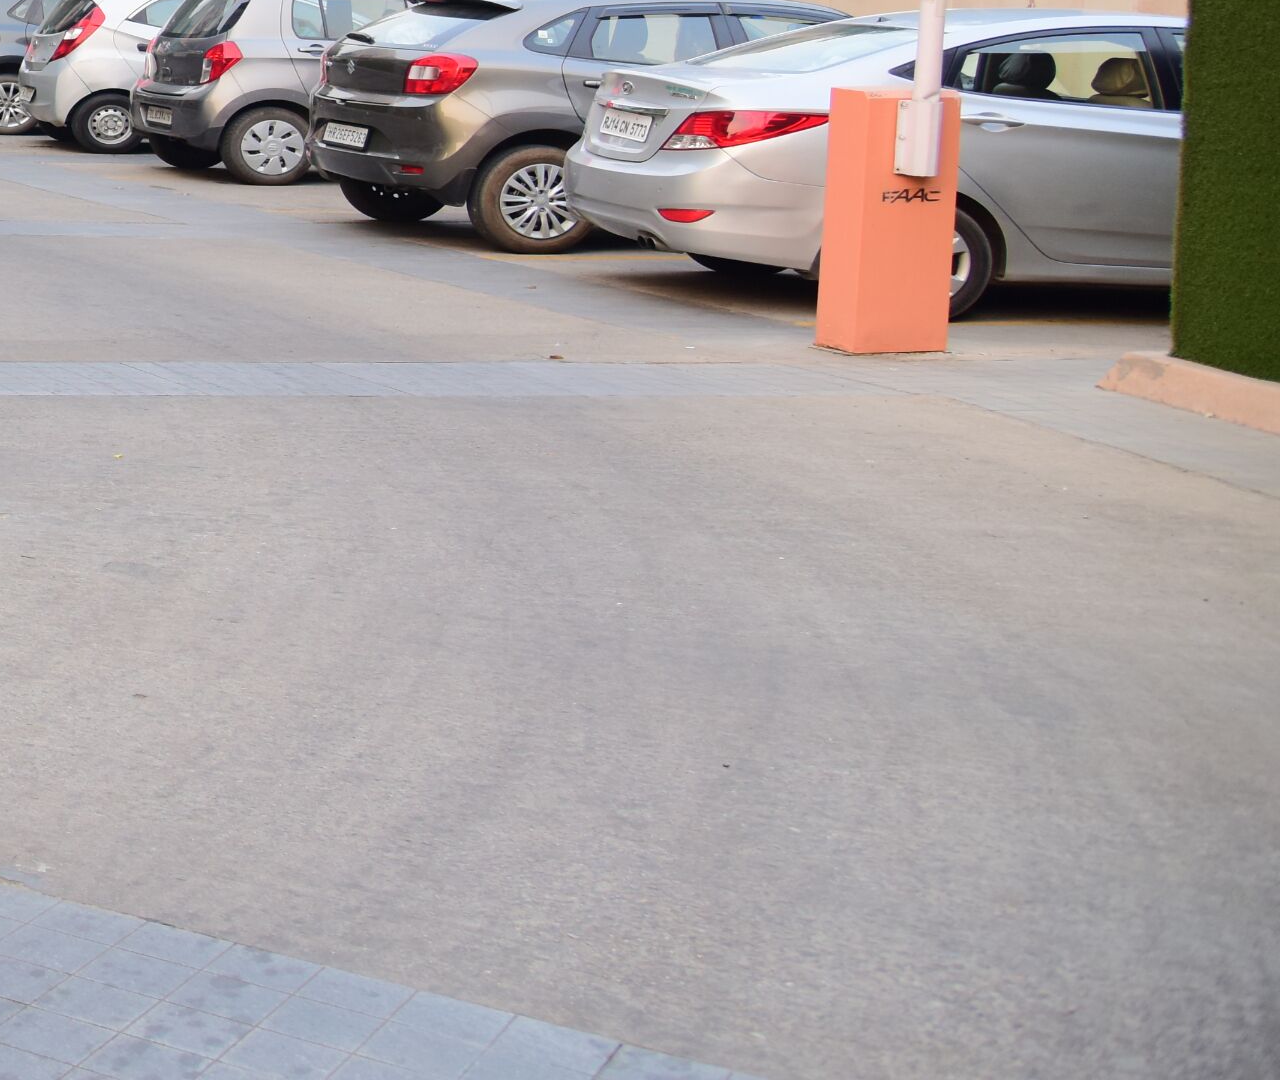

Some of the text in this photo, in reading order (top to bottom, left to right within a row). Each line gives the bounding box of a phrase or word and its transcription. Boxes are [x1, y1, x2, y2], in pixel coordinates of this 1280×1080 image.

[603, 116, 620, 131] RJ14
[619, 120, 630, 134] CN
[882, 188, 941, 203] FAAC
